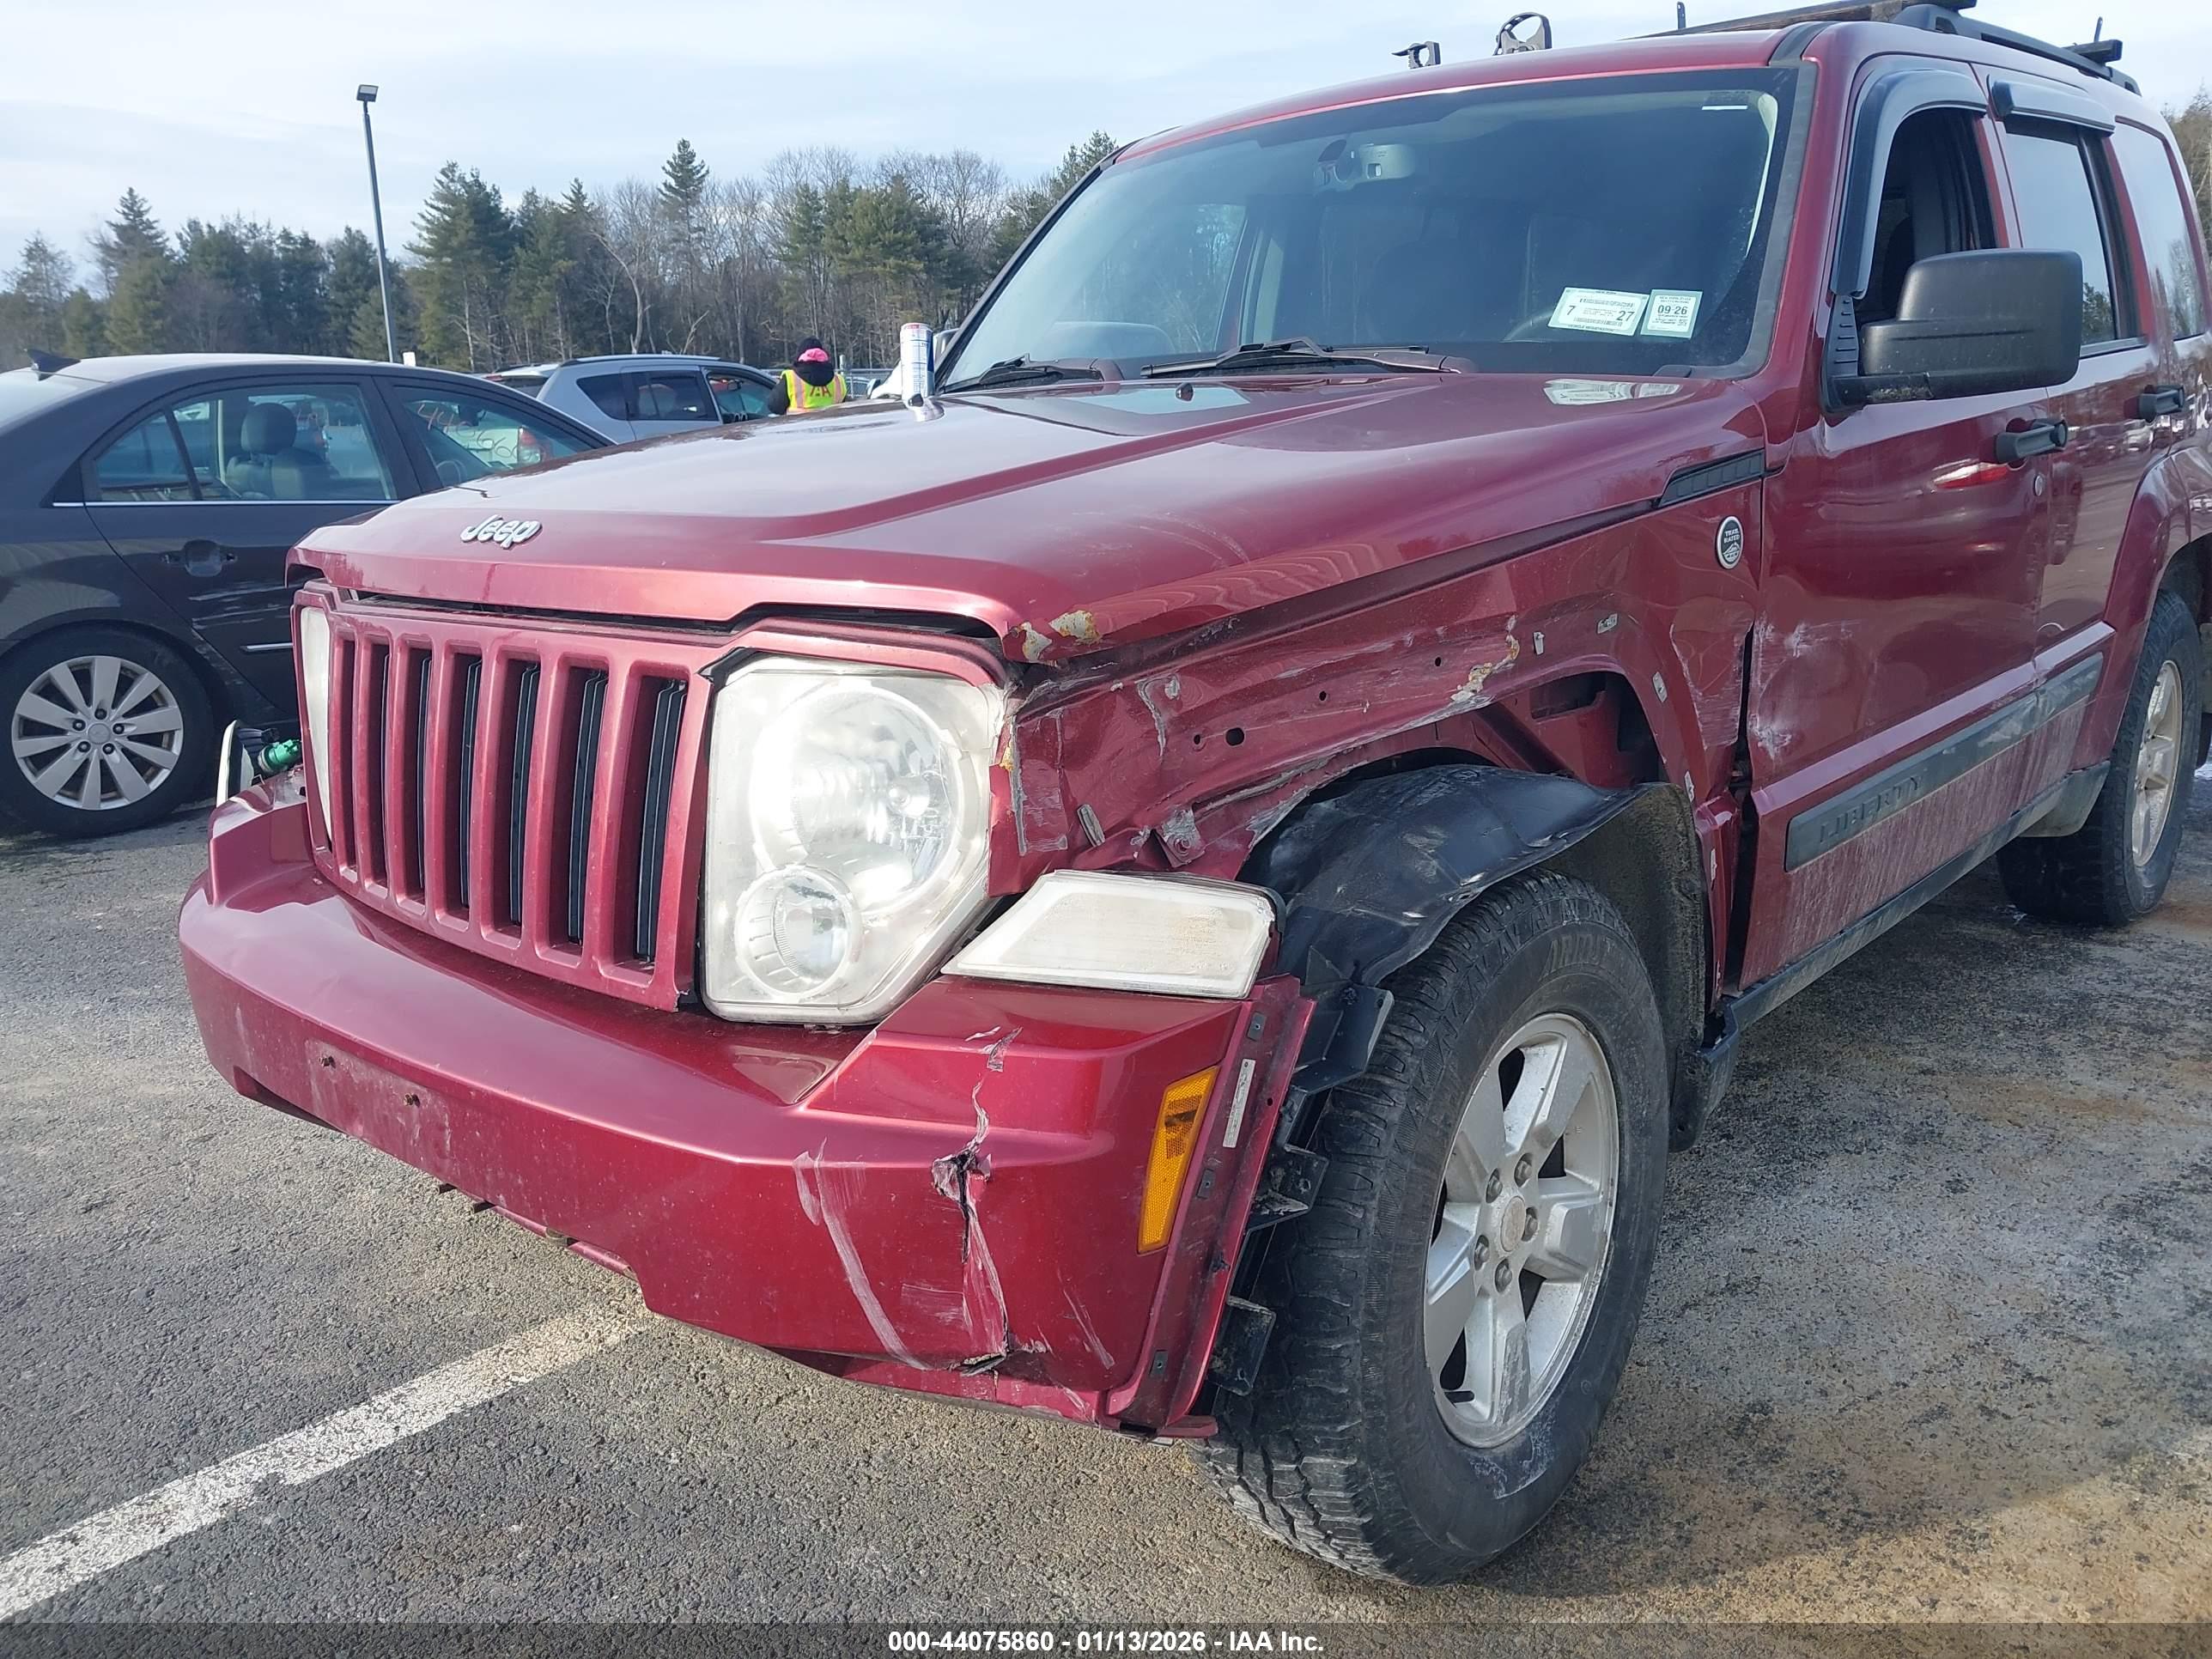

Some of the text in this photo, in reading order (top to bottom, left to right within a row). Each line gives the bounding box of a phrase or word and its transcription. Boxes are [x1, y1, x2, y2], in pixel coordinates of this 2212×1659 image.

[1566, 305, 1577, 316] 7
[1615, 310, 1636, 322] 27
[460, 514, 543, 550] Jeep
[1819, 775, 1923, 845] LIBERTY
